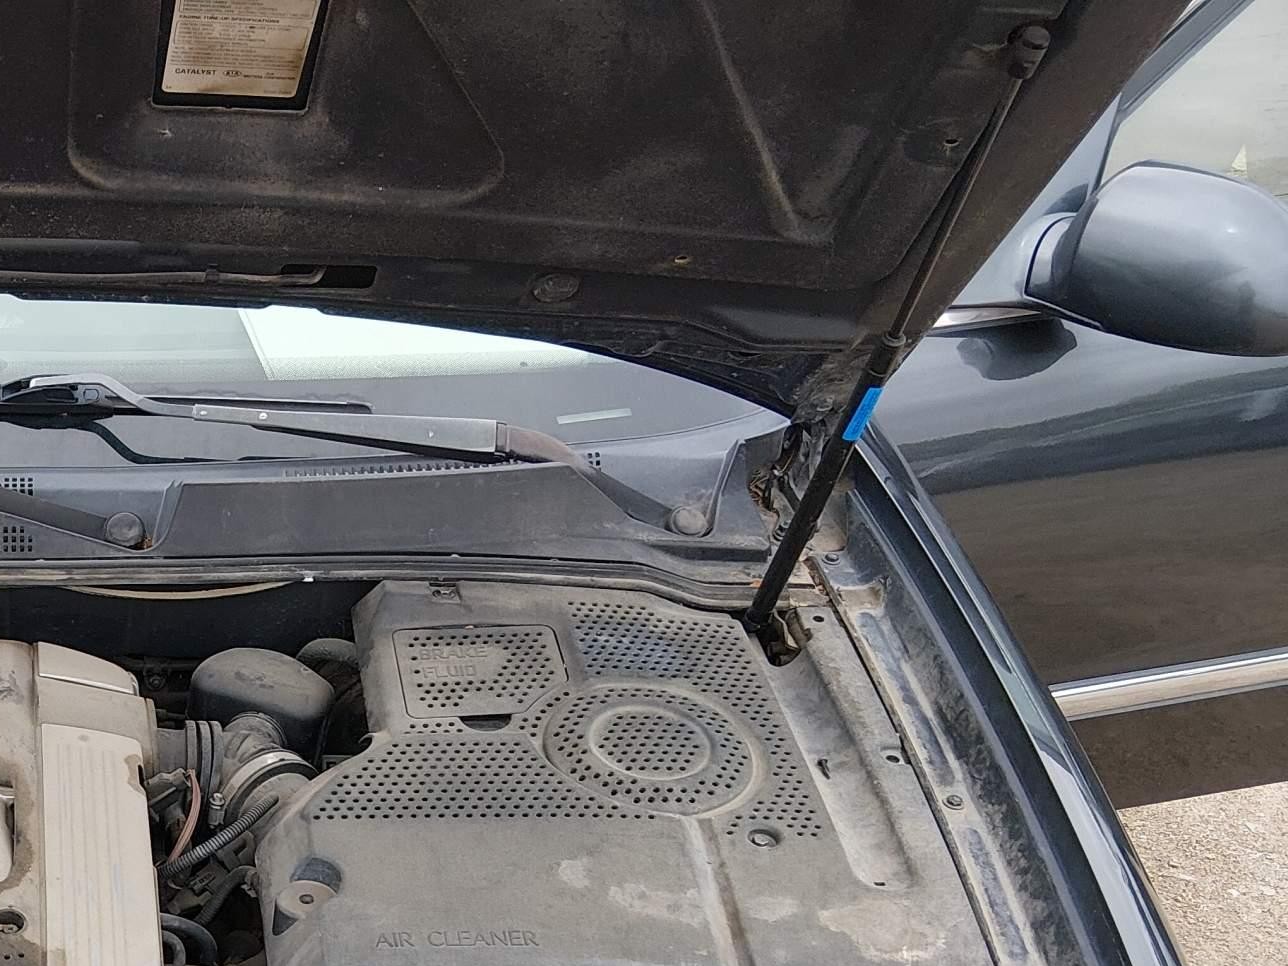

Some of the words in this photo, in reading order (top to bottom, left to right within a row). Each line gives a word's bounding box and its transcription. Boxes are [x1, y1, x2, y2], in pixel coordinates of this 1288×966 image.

[175, 67, 217, 76] CATALYST
[420, 646, 488, 660] BRAKE
[422, 665, 478, 678] FLUID
[375, 931, 415, 947] AIR
[426, 930, 540, 947] CLEANER
